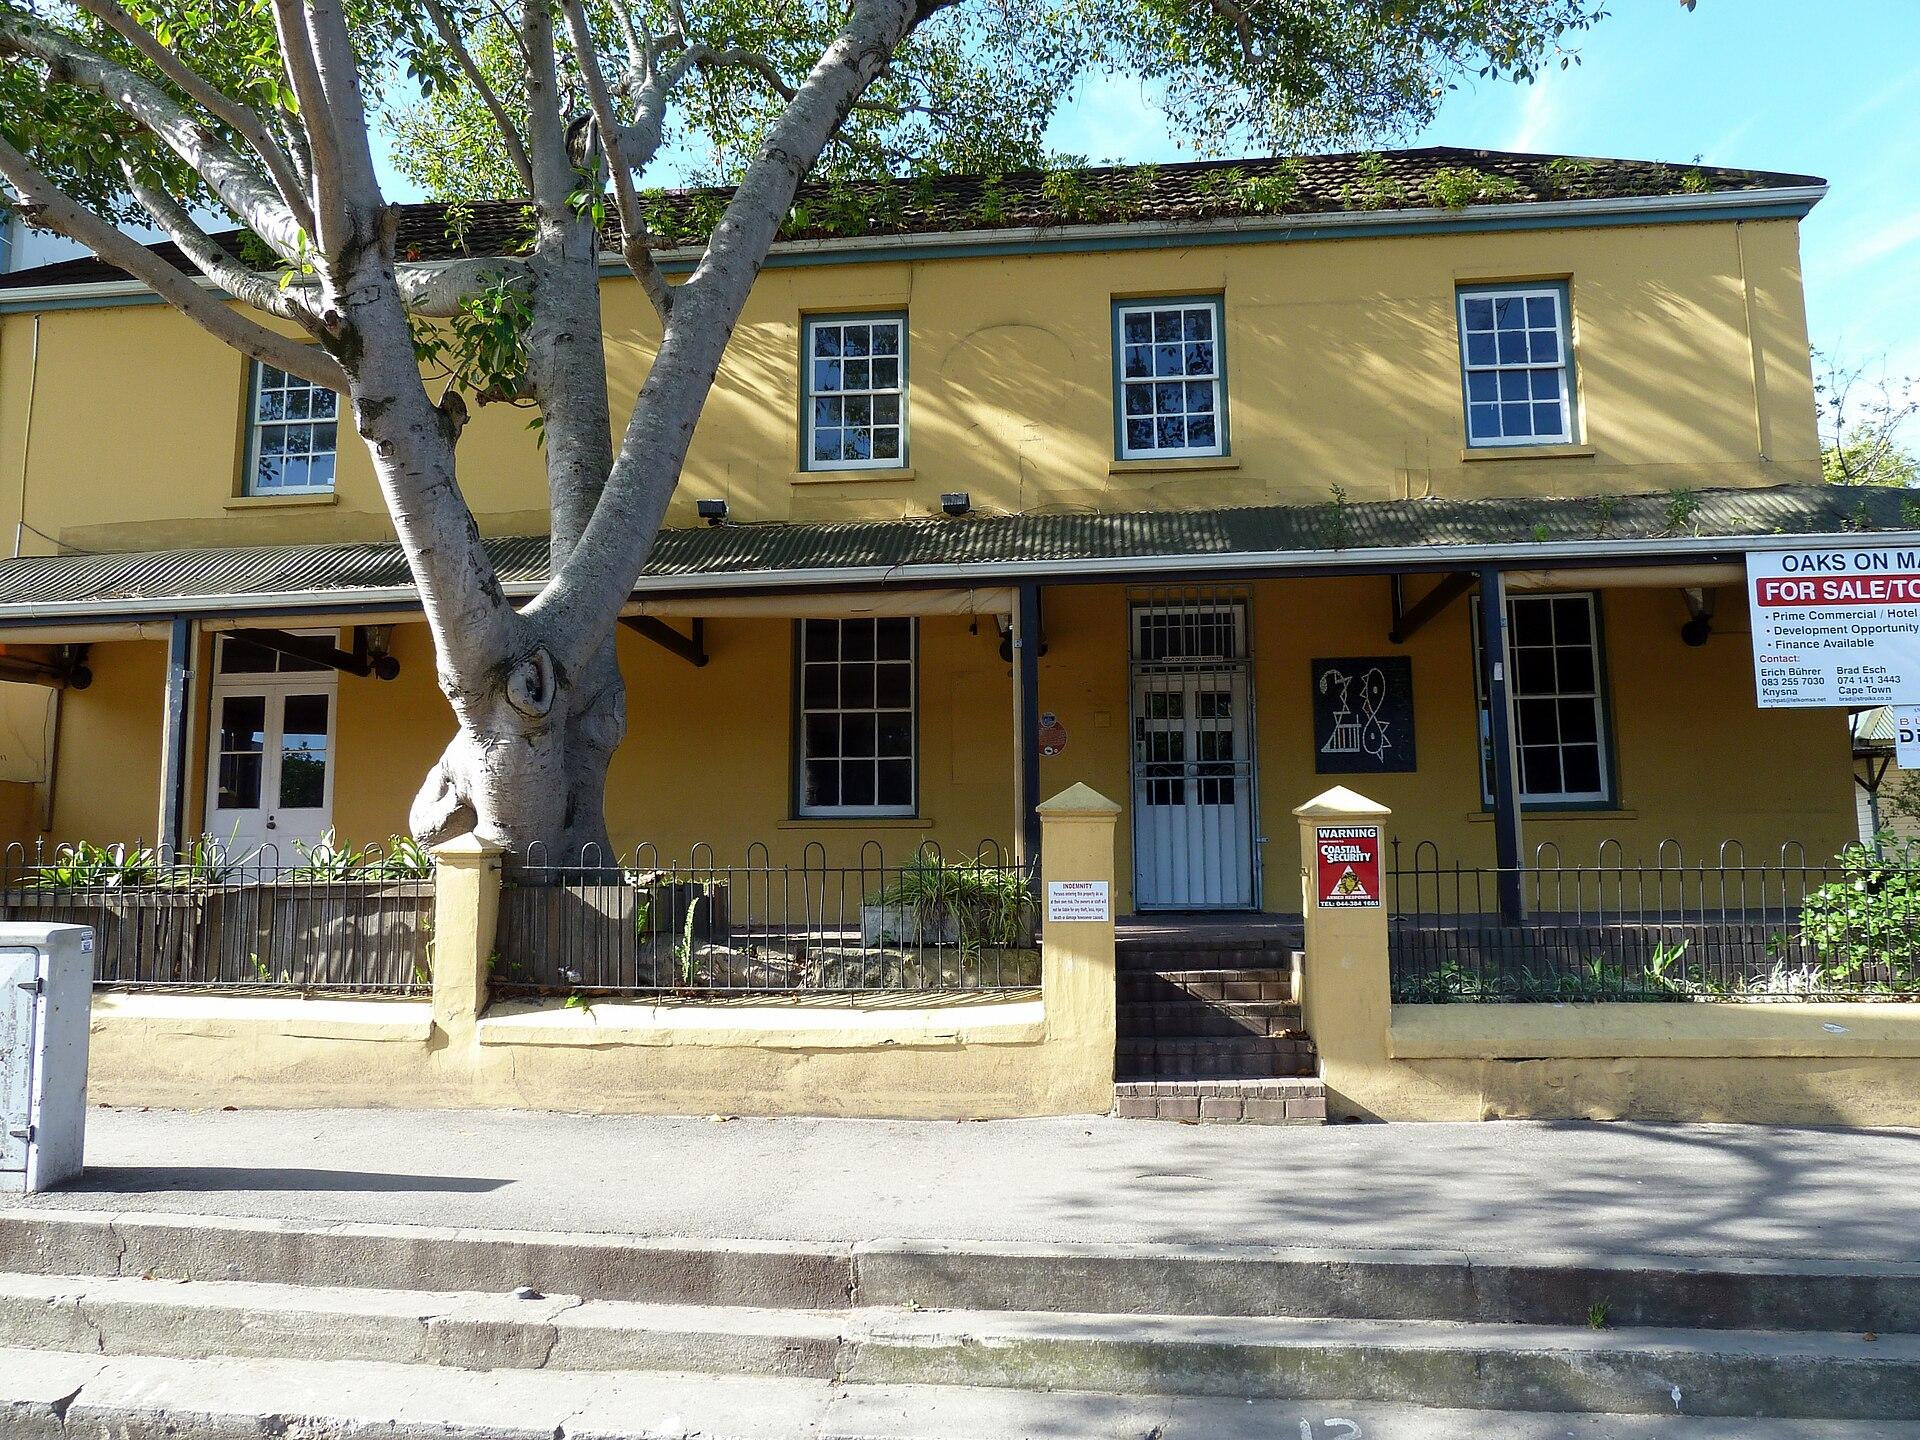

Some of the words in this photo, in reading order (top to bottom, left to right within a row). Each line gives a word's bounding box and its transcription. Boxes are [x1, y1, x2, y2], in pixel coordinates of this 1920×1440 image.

[1782, 553, 1846, 572] OAKS
[1854, 552, 1888, 570] ON
[1765, 582, 1816, 601] FOR
[1773, 611, 1805, 621] Prime
[1809, 610, 1877, 620] Commercial
[1887, 609, 1918, 618] Hotel
[1774, 625, 1848, 637] Development
[1851, 623, 1920, 635] Opportunity
[1775, 640, 1820, 650] Finance
[1823, 638, 1875, 649] Available
[1759, 654, 1801, 663] Contact:
[1761, 668, 1786, 677] Erich
[1789, 667, 1821, 676] Bührer
[1836, 666, 1859, 675] Brad
[1862, 666, 1887, 674] Esch
[1761, 678, 1779, 686] 083
[1782, 677, 1799, 686] 255
[1802, 677, 1825, 685] 7030
[1837, 676, 1855, 685] 074
[1858, 676, 1874, 684] 141
[1877, 675, 1901, 684] 3443
[1762, 688, 1798, 698] Knysna
[1838, 686, 1864, 695] Cape
[1866, 685, 1892, 694] Town
[1318, 829, 1377, 838] WARNING
[1320, 845, 1361, 855] COASTAL
[1327, 853, 1371, 863] SECURITY
